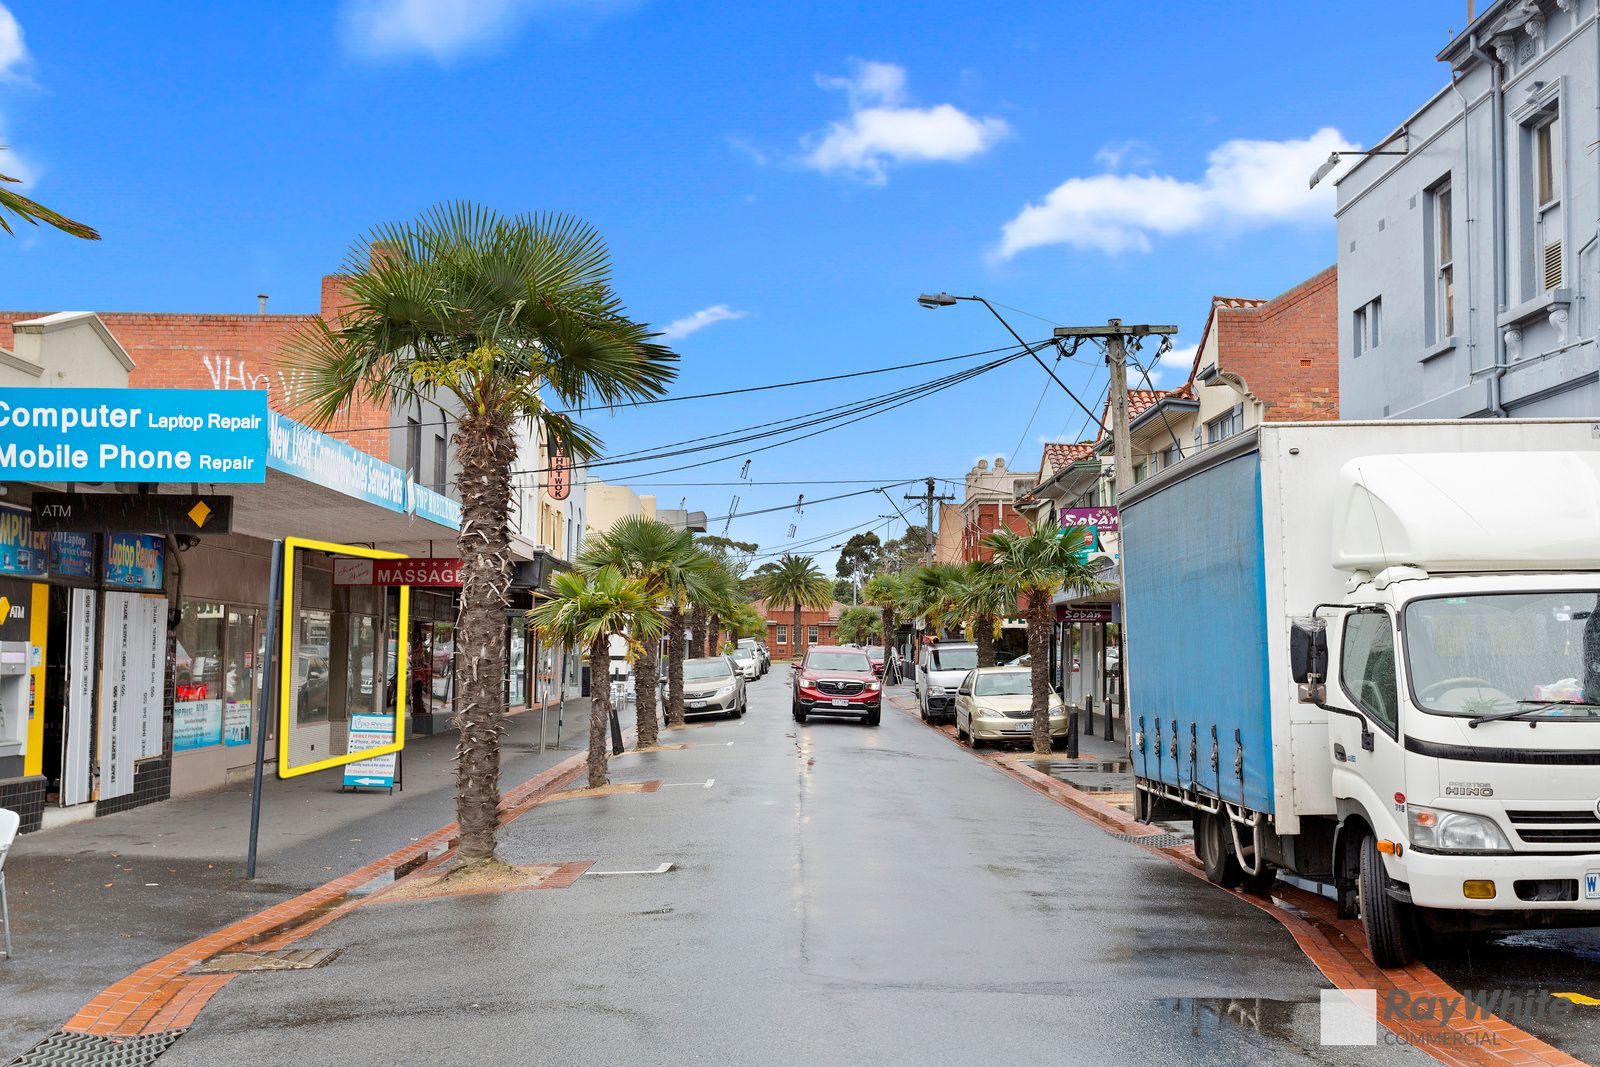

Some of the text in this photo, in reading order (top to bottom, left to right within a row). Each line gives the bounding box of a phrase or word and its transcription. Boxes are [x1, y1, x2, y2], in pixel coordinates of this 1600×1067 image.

[149, 413, 203, 431] Laptop
[208, 413, 261, 432] Repair
[0, 443, 254, 472] Mobile Phone Repair
[555, 478, 563, 497] WOK
[42, 504, 71, 517] ATM
[109, 536, 134, 575] Laptop
[378, 569, 464, 583] MASSAGE
[10, 605, 24, 619] ATM
[1065, 610, 1102, 619] Soban
[1446, 787, 1494, 797] HINO
